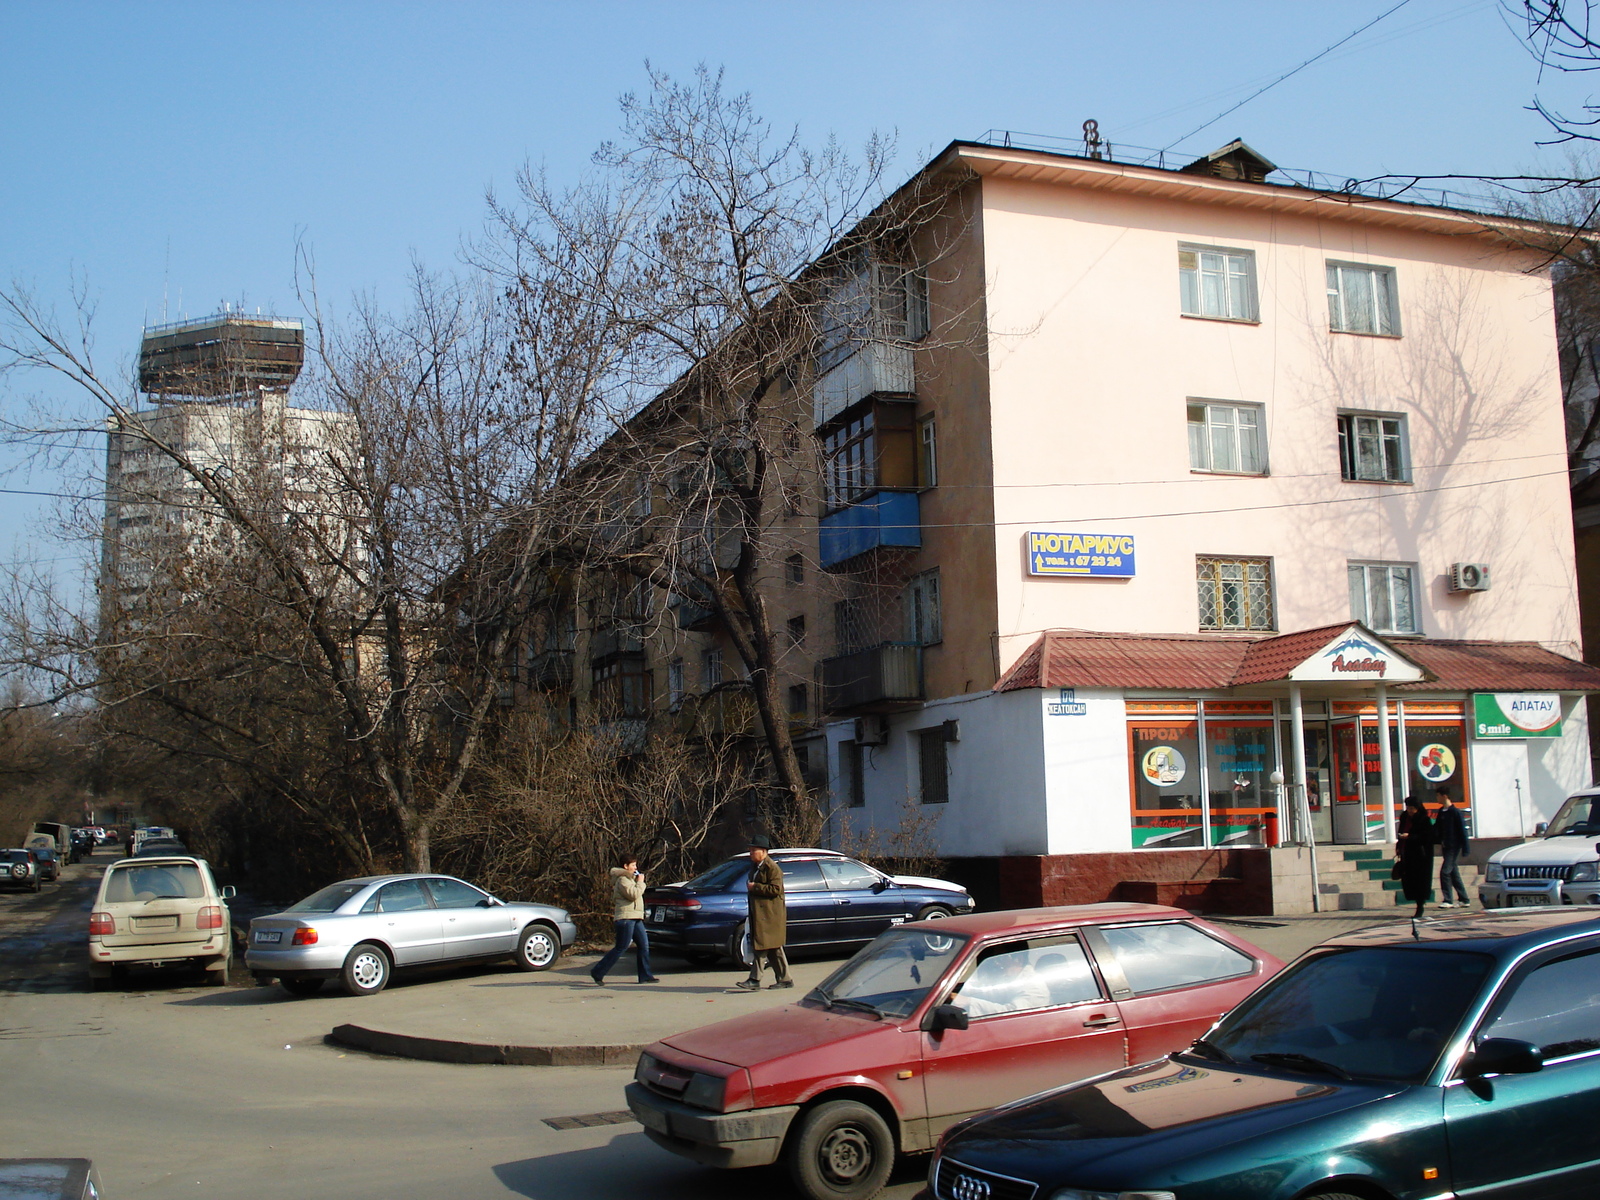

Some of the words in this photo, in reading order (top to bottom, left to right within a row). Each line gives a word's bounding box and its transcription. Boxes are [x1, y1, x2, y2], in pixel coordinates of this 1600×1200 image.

[1031, 533, 1134, 555] НОТАРИУС
[1075, 556, 1090, 566] 67
[1107, 557, 1122, 567] 24
[1332, 654, 1387, 678] Алатау
[1511, 701, 1554, 711] АЛАТАУ
